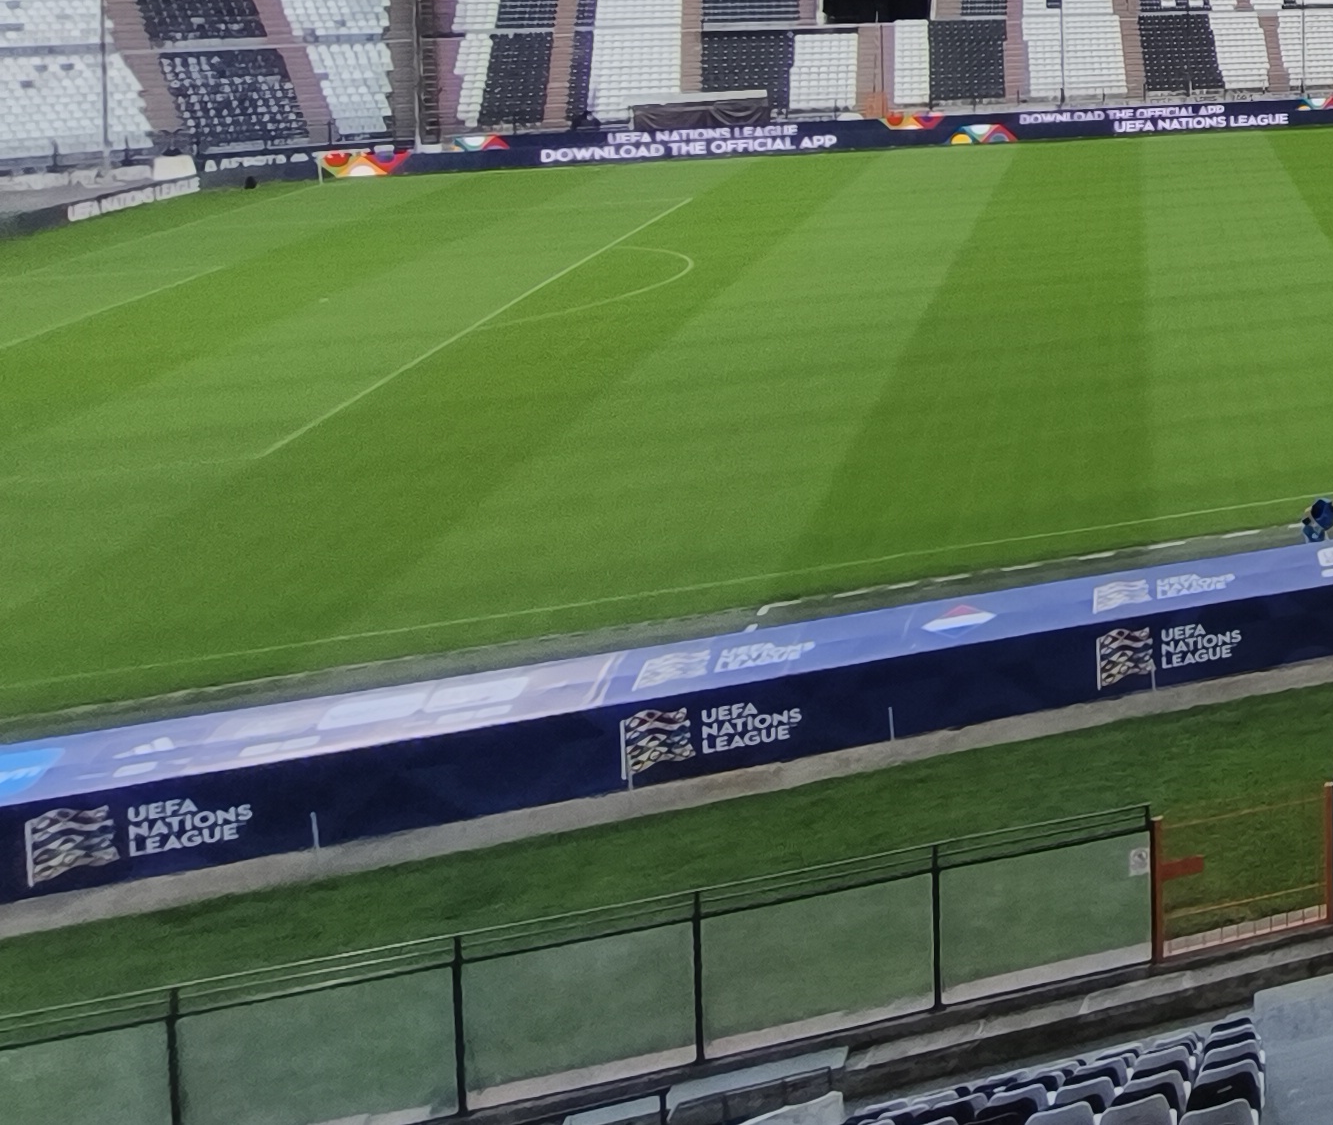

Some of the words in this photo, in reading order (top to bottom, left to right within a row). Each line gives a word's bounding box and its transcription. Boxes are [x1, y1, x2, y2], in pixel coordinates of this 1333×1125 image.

[1019, 110, 1105, 125] DOWNLOAD
[1106, 108, 1134, 120] THE
[1136, 106, 1196, 118] OFFICIAL
[1114, 120, 1155, 133] UEFA
[1157, 116, 1227, 131] NATIONS
[1230, 114, 1288, 127] LEAGUE
[607, 131, 652, 145] UEFA
[655, 127, 731, 142] NATIONS
[734, 124, 798, 138] LEAGUE
[541, 143, 664, 163] DOWNLOAD
[668, 141, 707, 156] THE
[710, 137, 796, 154] OFFICIAL
[800, 134, 837, 149] APP
[1161, 623, 1207, 642] UEFA
[1161, 629, 1242, 656] NATIONS
[1161, 644, 1233, 669] LEAGUE
[701, 702, 758, 725] UEFA
[701, 707, 802, 739] NATIONS
[701, 724, 791, 754] LEAGUE
[127, 797, 198, 823] UEFA
[128, 803, 253, 840] NATIONS
[129, 823, 240, 858] LEAGUE
